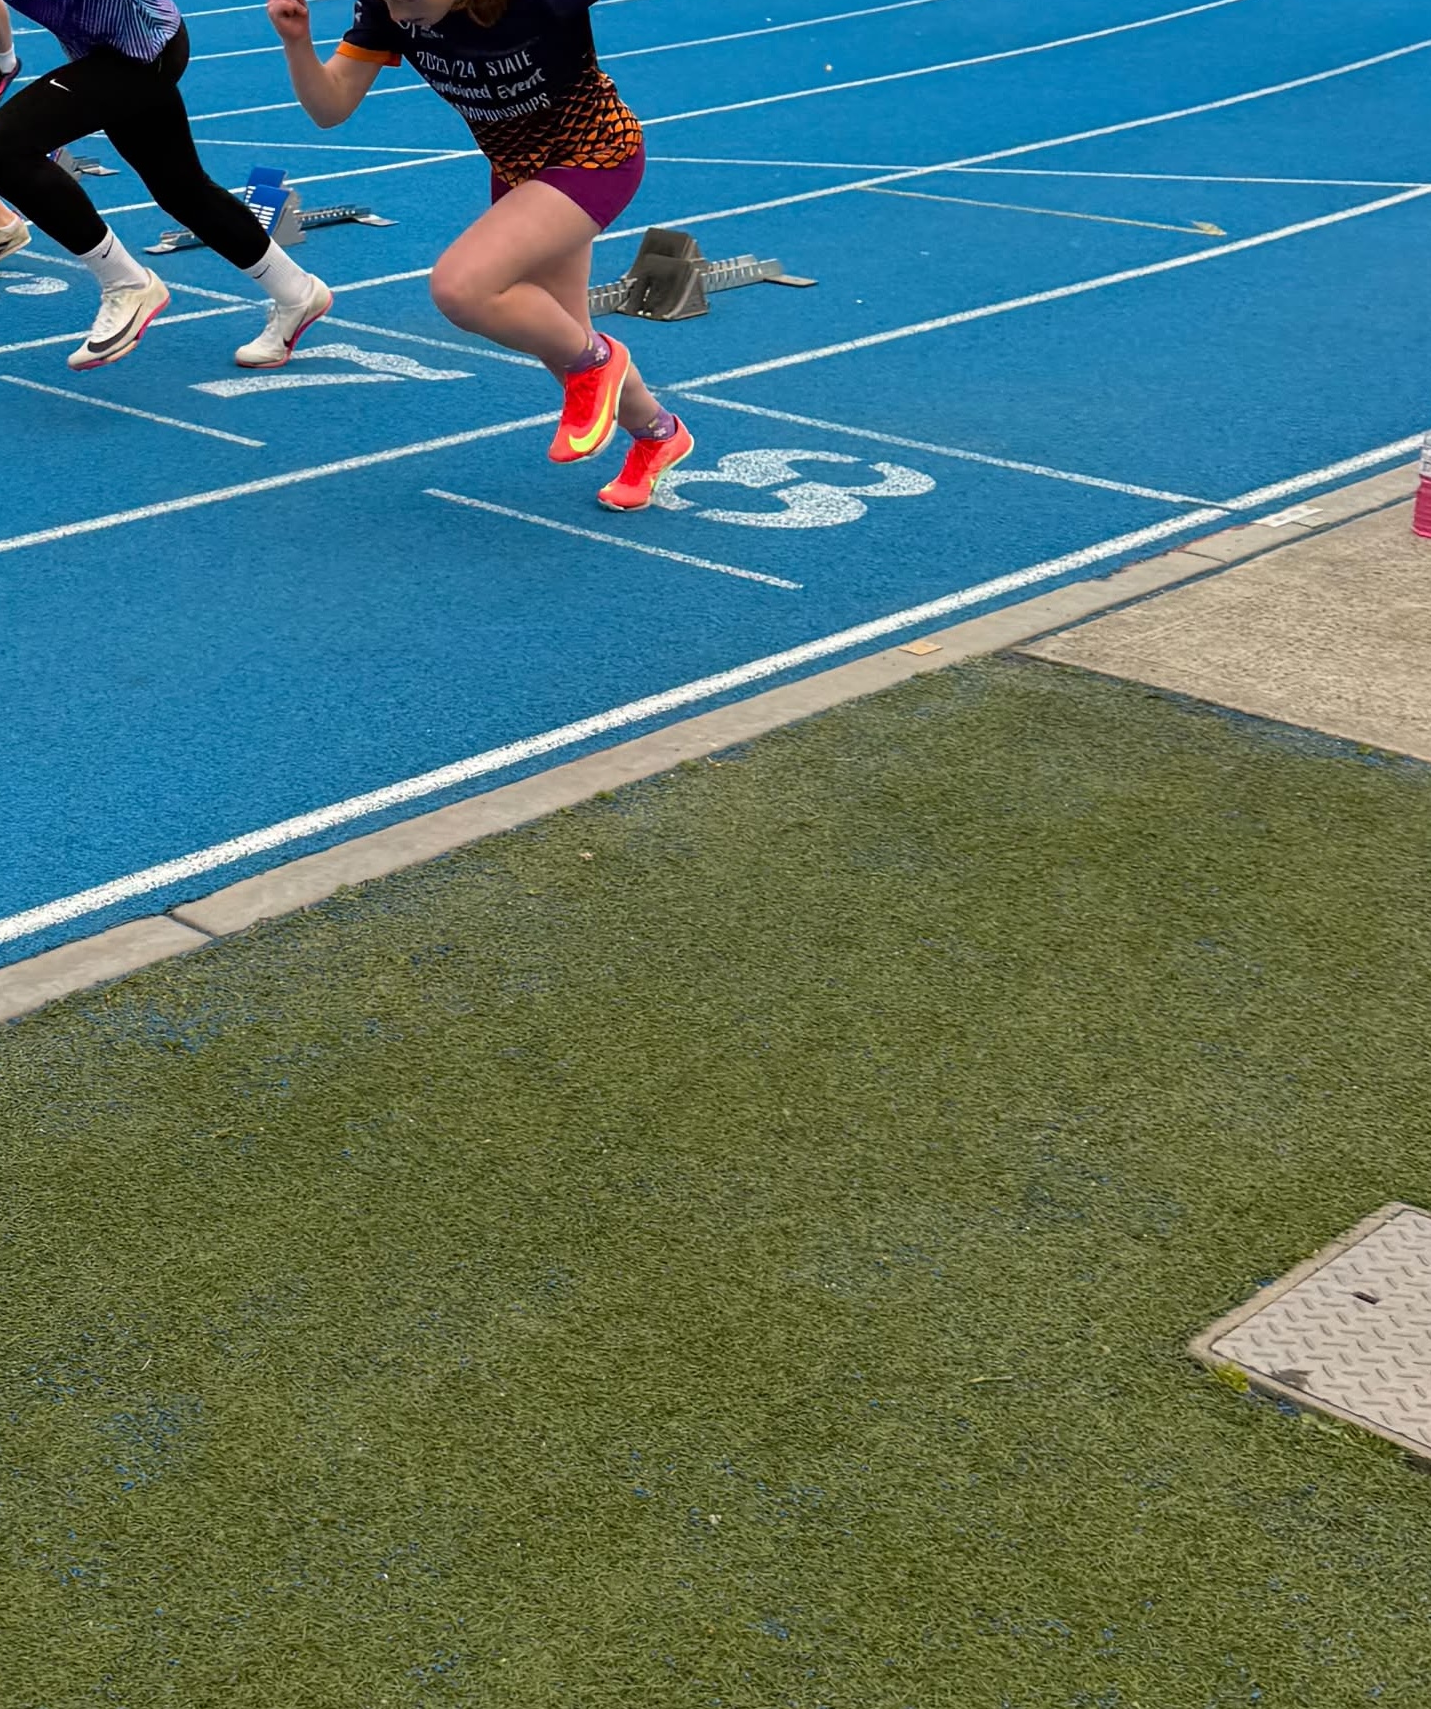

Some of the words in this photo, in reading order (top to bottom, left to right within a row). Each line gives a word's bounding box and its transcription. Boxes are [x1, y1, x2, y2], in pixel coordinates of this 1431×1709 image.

[416, 51, 477, 79] 2023/24
[485, 50, 533, 78] STATE
[187, 342, 477, 399] 7
[649, 448, 937, 530] 8
